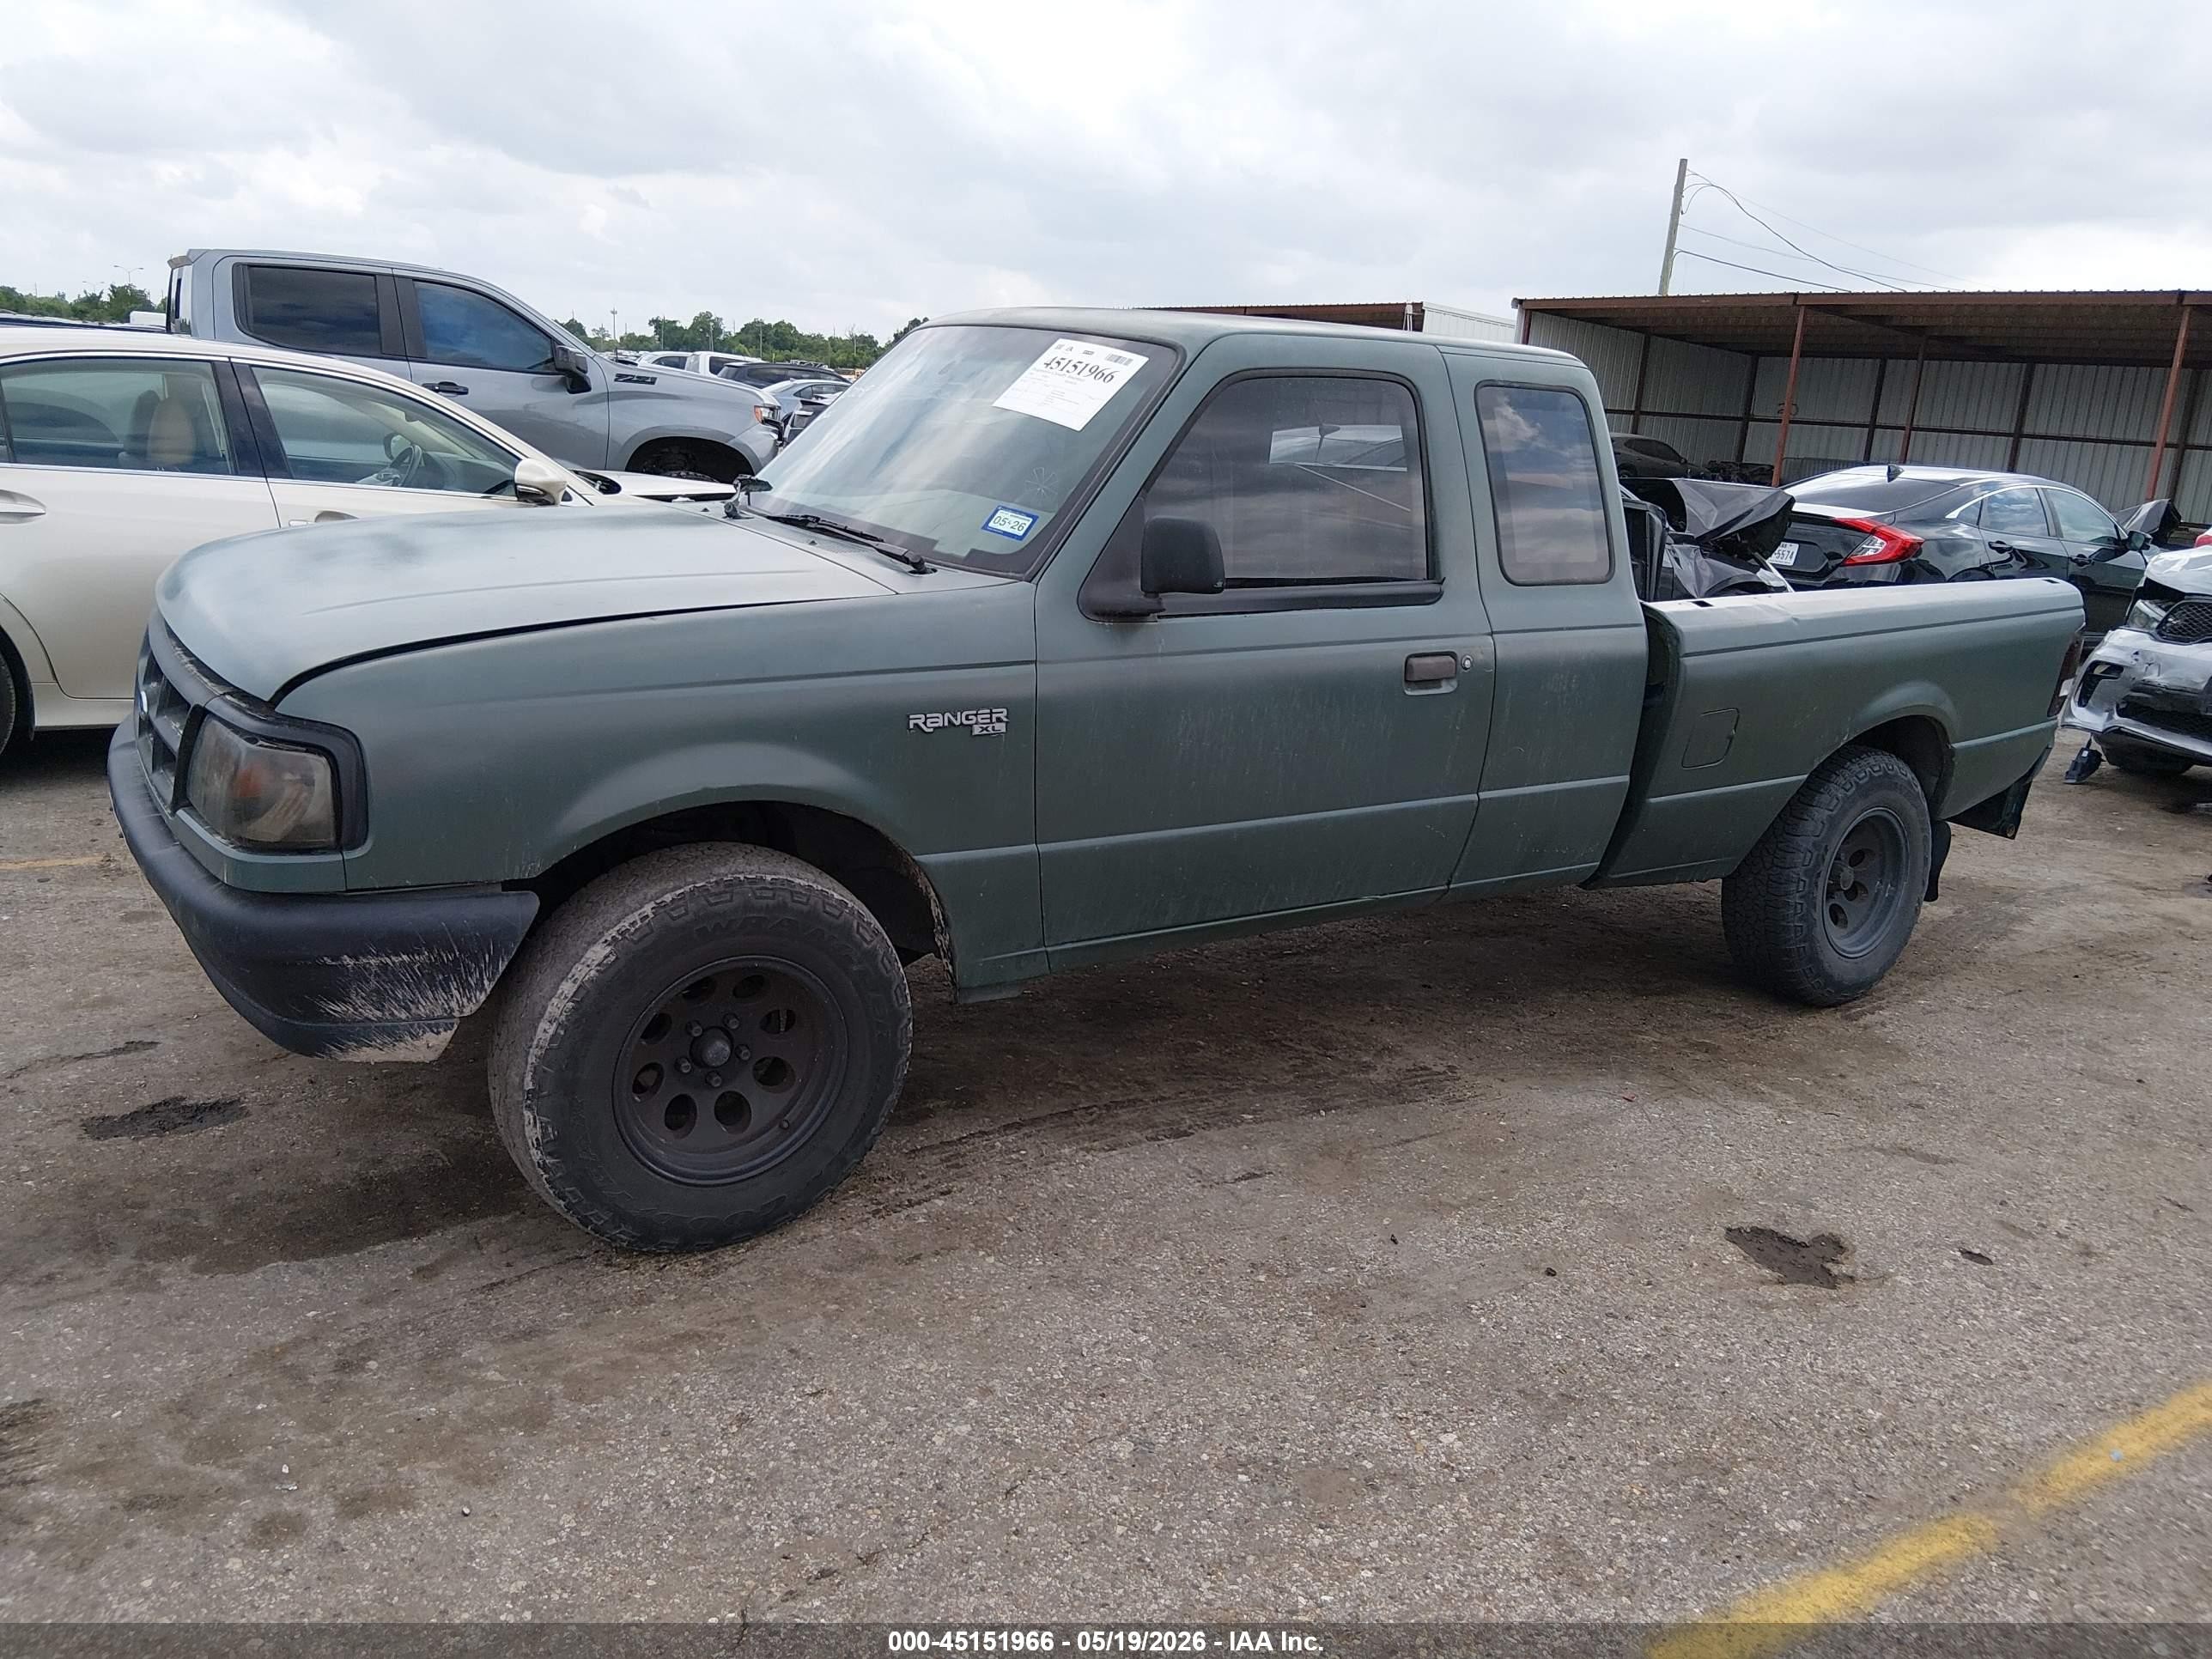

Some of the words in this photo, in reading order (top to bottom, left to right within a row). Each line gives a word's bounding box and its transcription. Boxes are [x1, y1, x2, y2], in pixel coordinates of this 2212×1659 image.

[1044, 356, 1120, 383] 45151966
[908, 708, 1010, 732] RANGER
[975, 724, 1005, 734] XL
